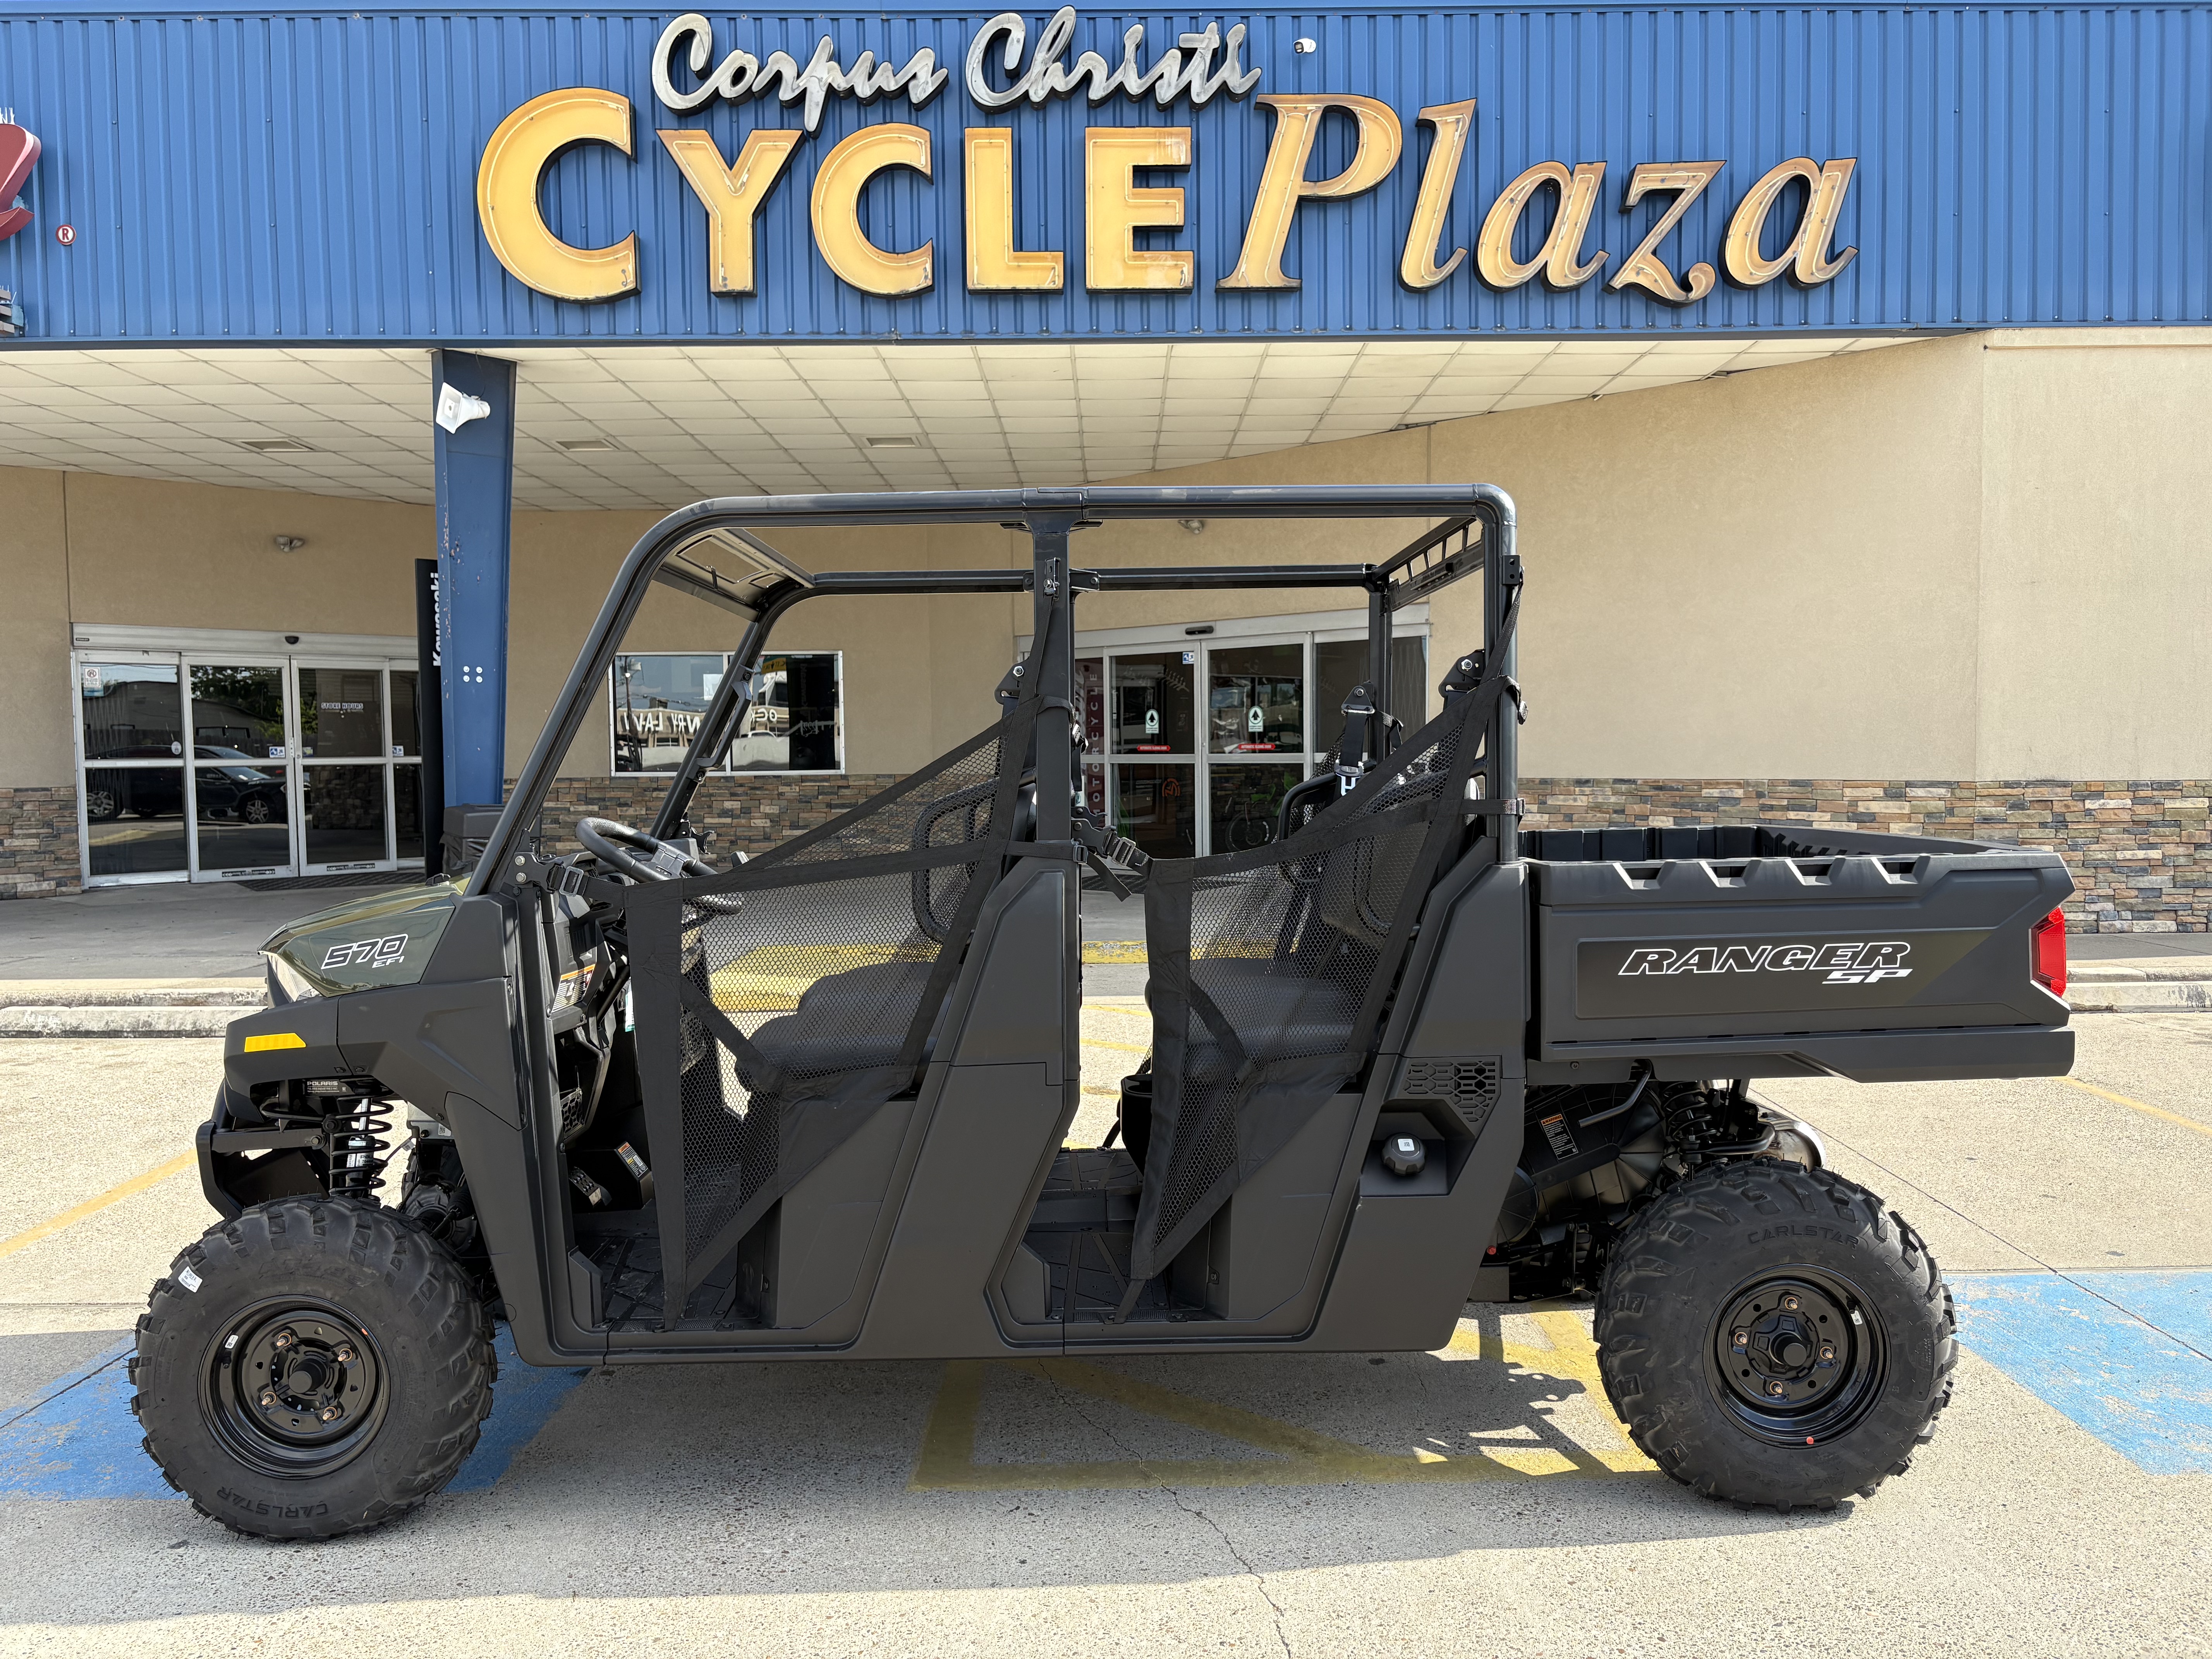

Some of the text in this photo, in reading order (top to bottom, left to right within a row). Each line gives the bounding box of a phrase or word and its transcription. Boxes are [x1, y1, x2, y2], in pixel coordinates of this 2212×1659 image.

[652, 5, 1262, 136] Corpus Christi
[477, 87, 1858, 305] CYCLE Plaza
[321, 934, 408, 969] 570
[372, 956, 404, 968] EFI
[1618, 942, 1910, 975] RANGER
[1822, 969, 1913, 984] SP
[1748, 1225, 1859, 1249] CARLSTAR
[216, 1486, 328, 1518] CARLSTAR
